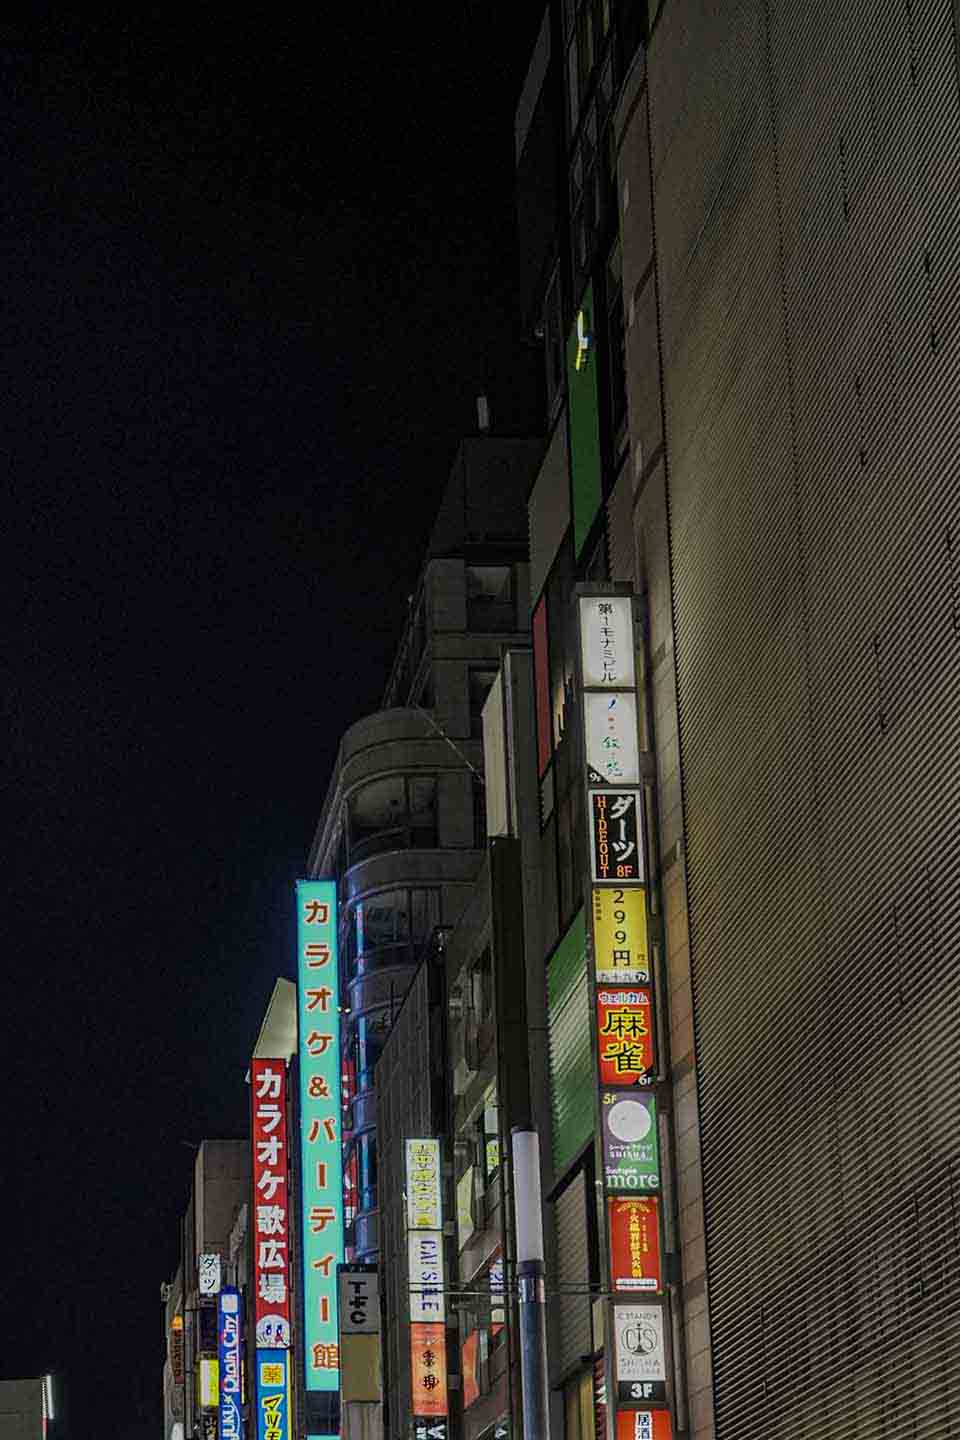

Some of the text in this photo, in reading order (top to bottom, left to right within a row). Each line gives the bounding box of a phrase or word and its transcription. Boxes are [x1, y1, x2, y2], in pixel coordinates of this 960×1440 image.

[596, 796, 608, 878] HIDEOUT
[610, 796, 634, 861] ダーツ
[617, 866, 632, 878] 8F
[612, 889, 631, 967] 299円
[598, 992, 648, 1004] ウェルカム
[601, 1007, 647, 1074] 麻雀
[304, 900, 338, 1370] カラオケ&パーティー館
[256, 1068, 286, 1304] カラオケ歌広場
[606, 1174, 659, 1188] more
[631, 1383, 653, 1398] 3F
